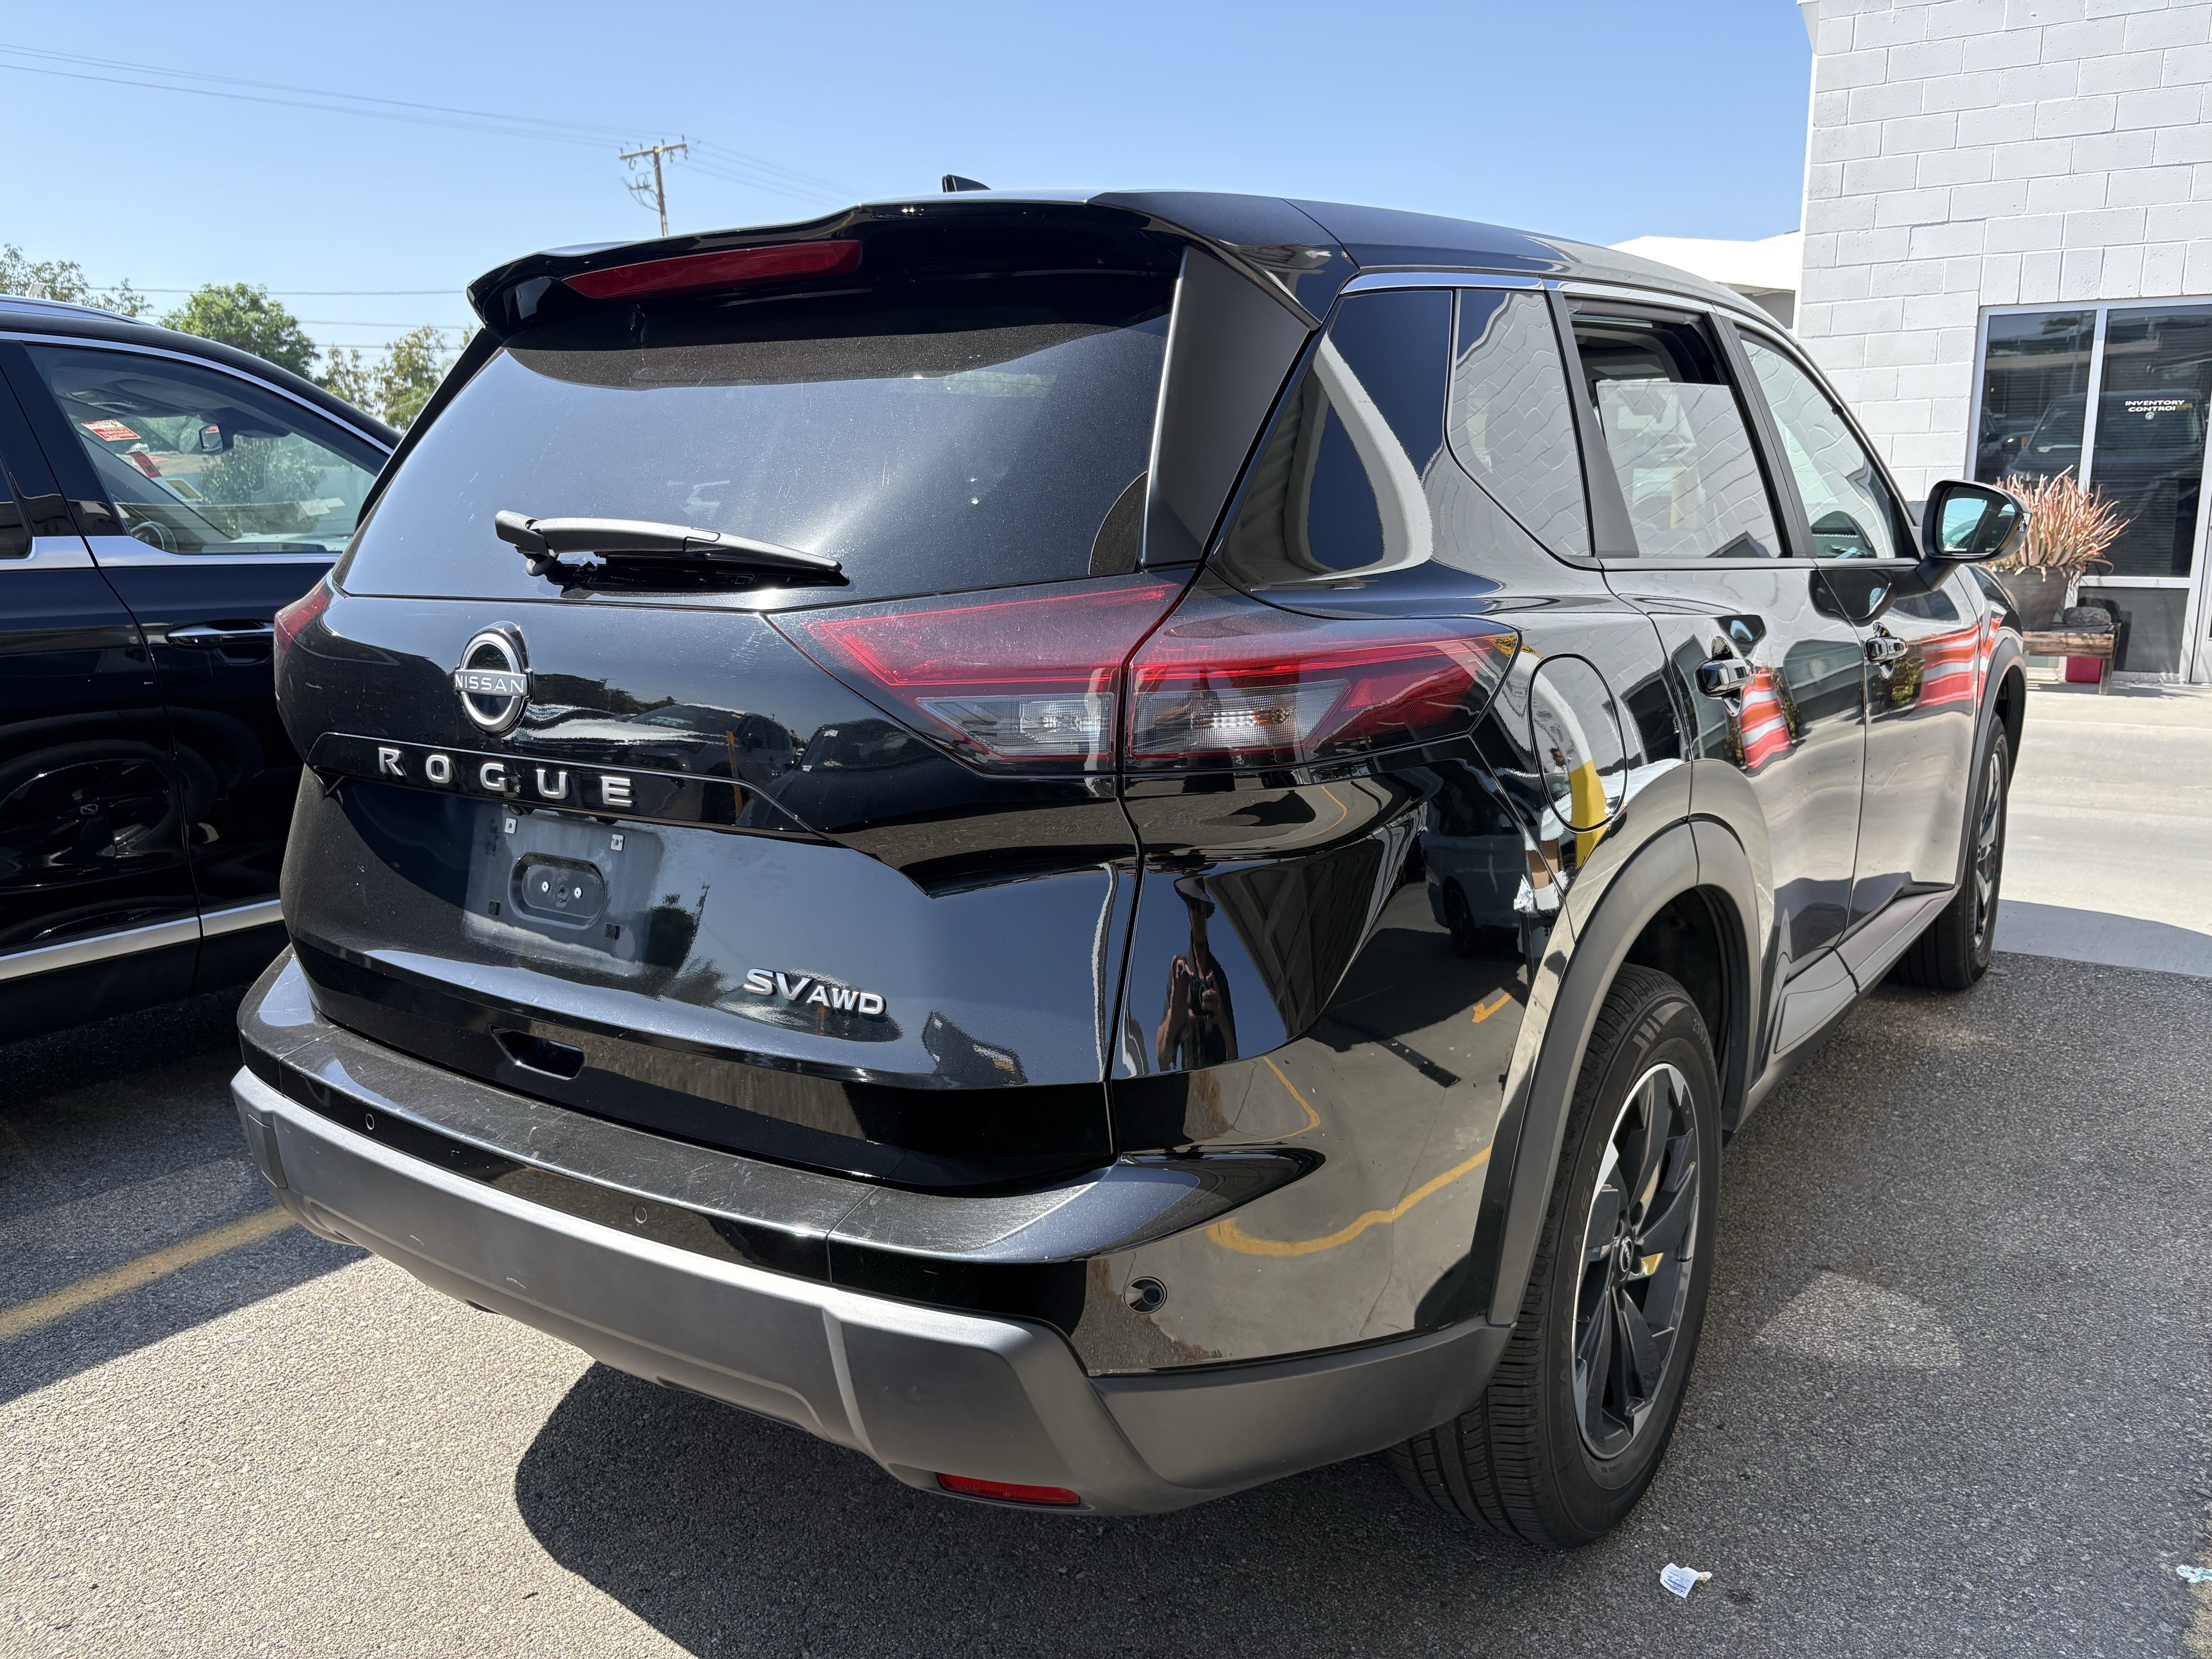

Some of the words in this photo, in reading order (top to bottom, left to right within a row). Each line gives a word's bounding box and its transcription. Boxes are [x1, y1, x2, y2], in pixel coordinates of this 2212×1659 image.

[455, 674, 524, 693] NISSAN
[378, 747, 633, 807] ROGUE
[744, 969, 812, 1001] SV
[806, 986, 887, 1015] AWD
